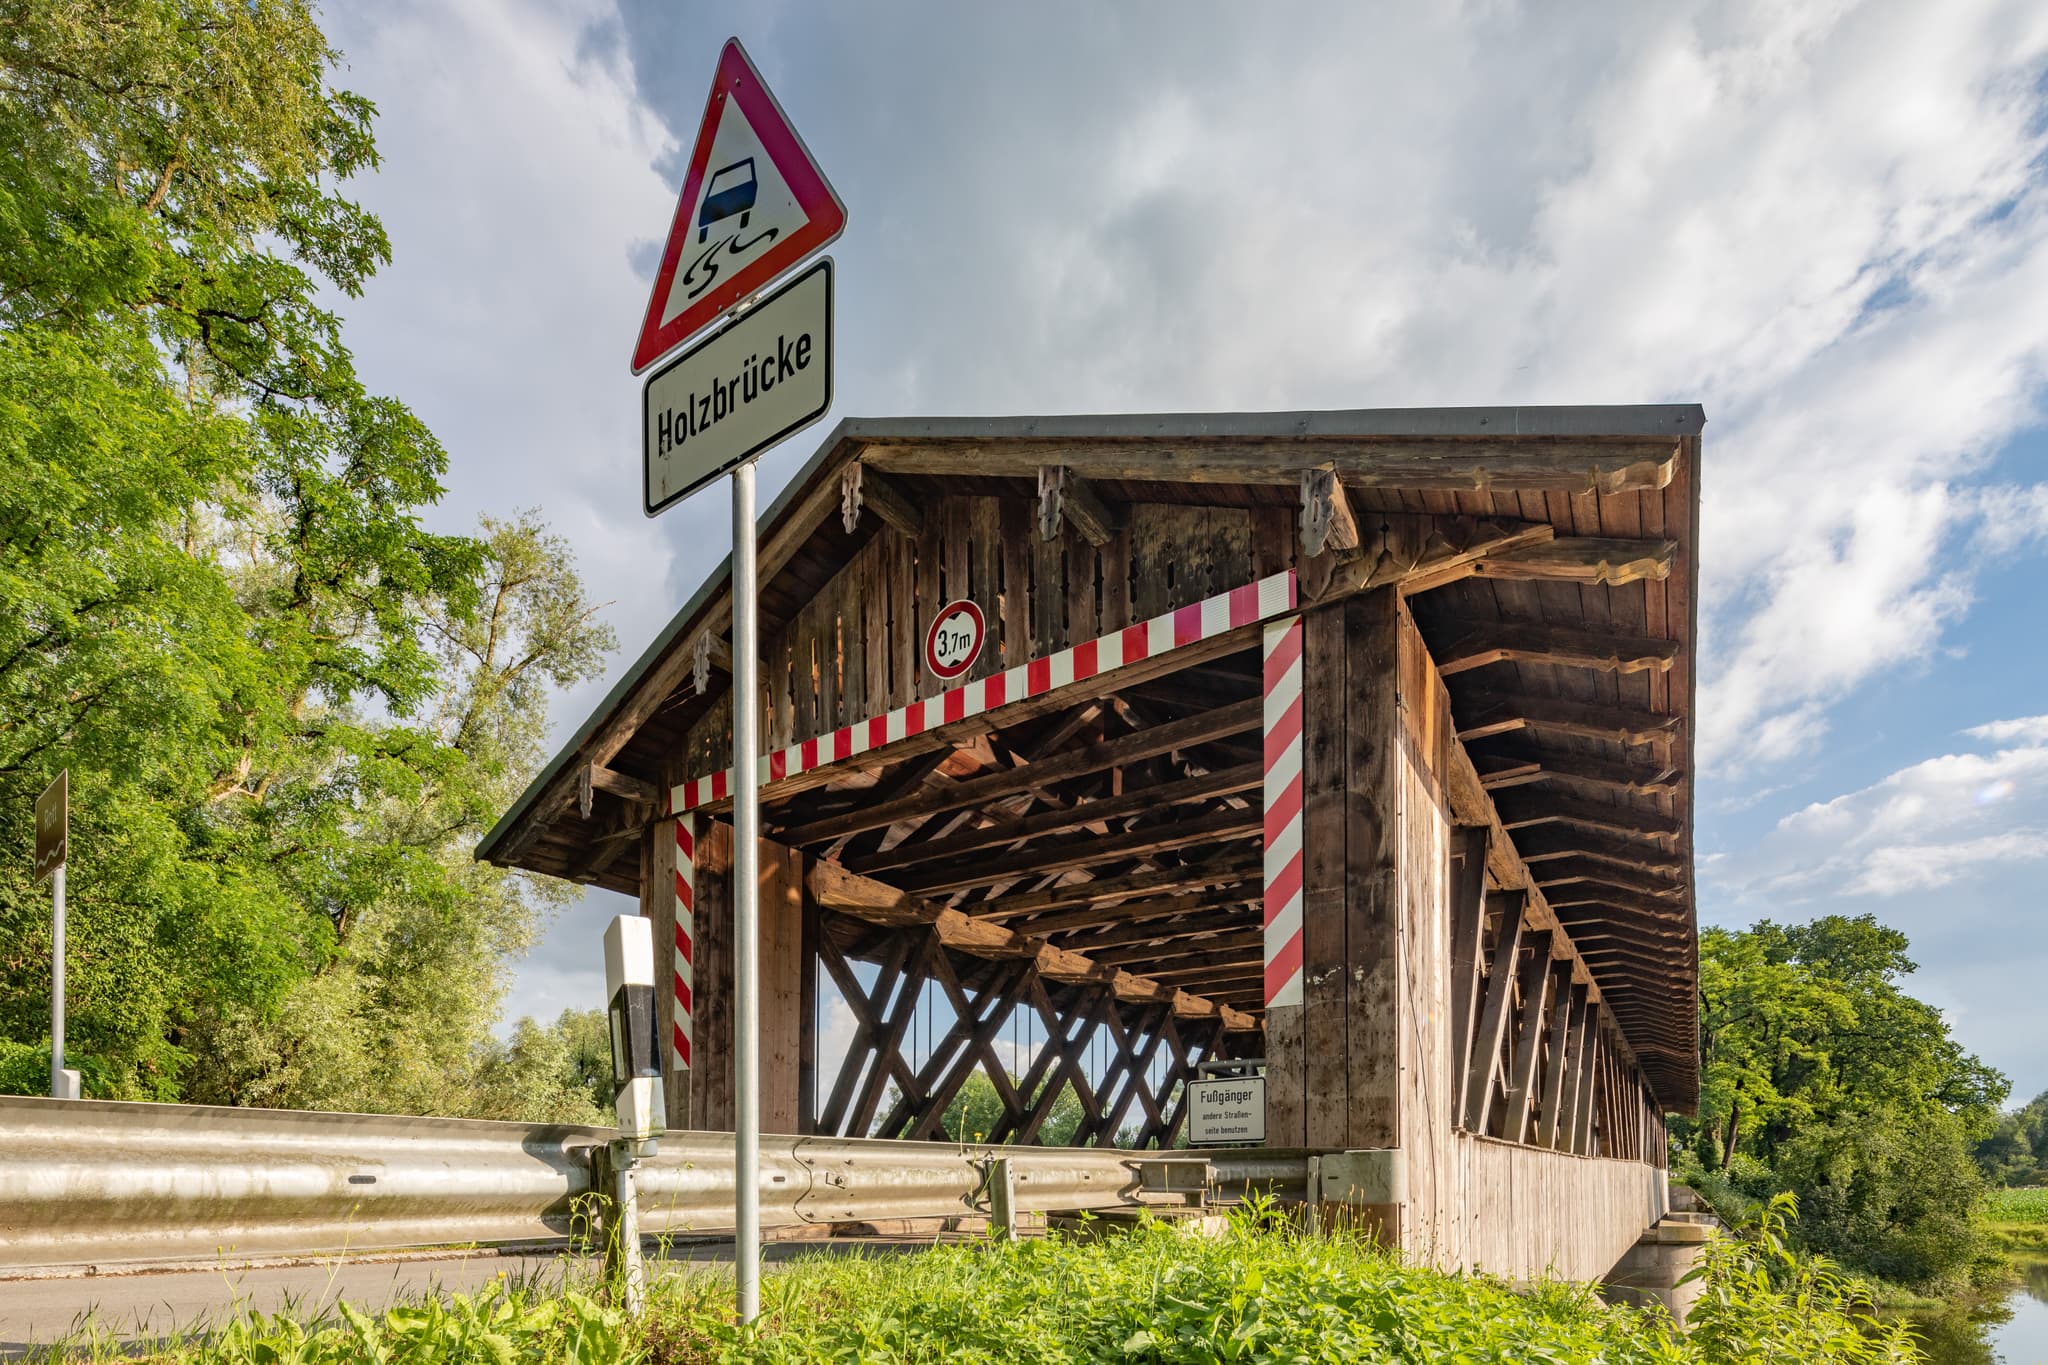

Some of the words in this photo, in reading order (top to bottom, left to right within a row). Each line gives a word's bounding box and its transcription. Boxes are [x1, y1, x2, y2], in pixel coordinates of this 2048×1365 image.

[658, 333, 811, 457] Holzbrücke
[1200, 1090, 1253, 1105] Fußgänger
[1203, 1112, 1222, 1120] andere
[1224, 1110, 1252, 1119] Straßen-
[1205, 1126, 1219, 1135] seite
[1220, 1125, 1248, 1134] benutzen
